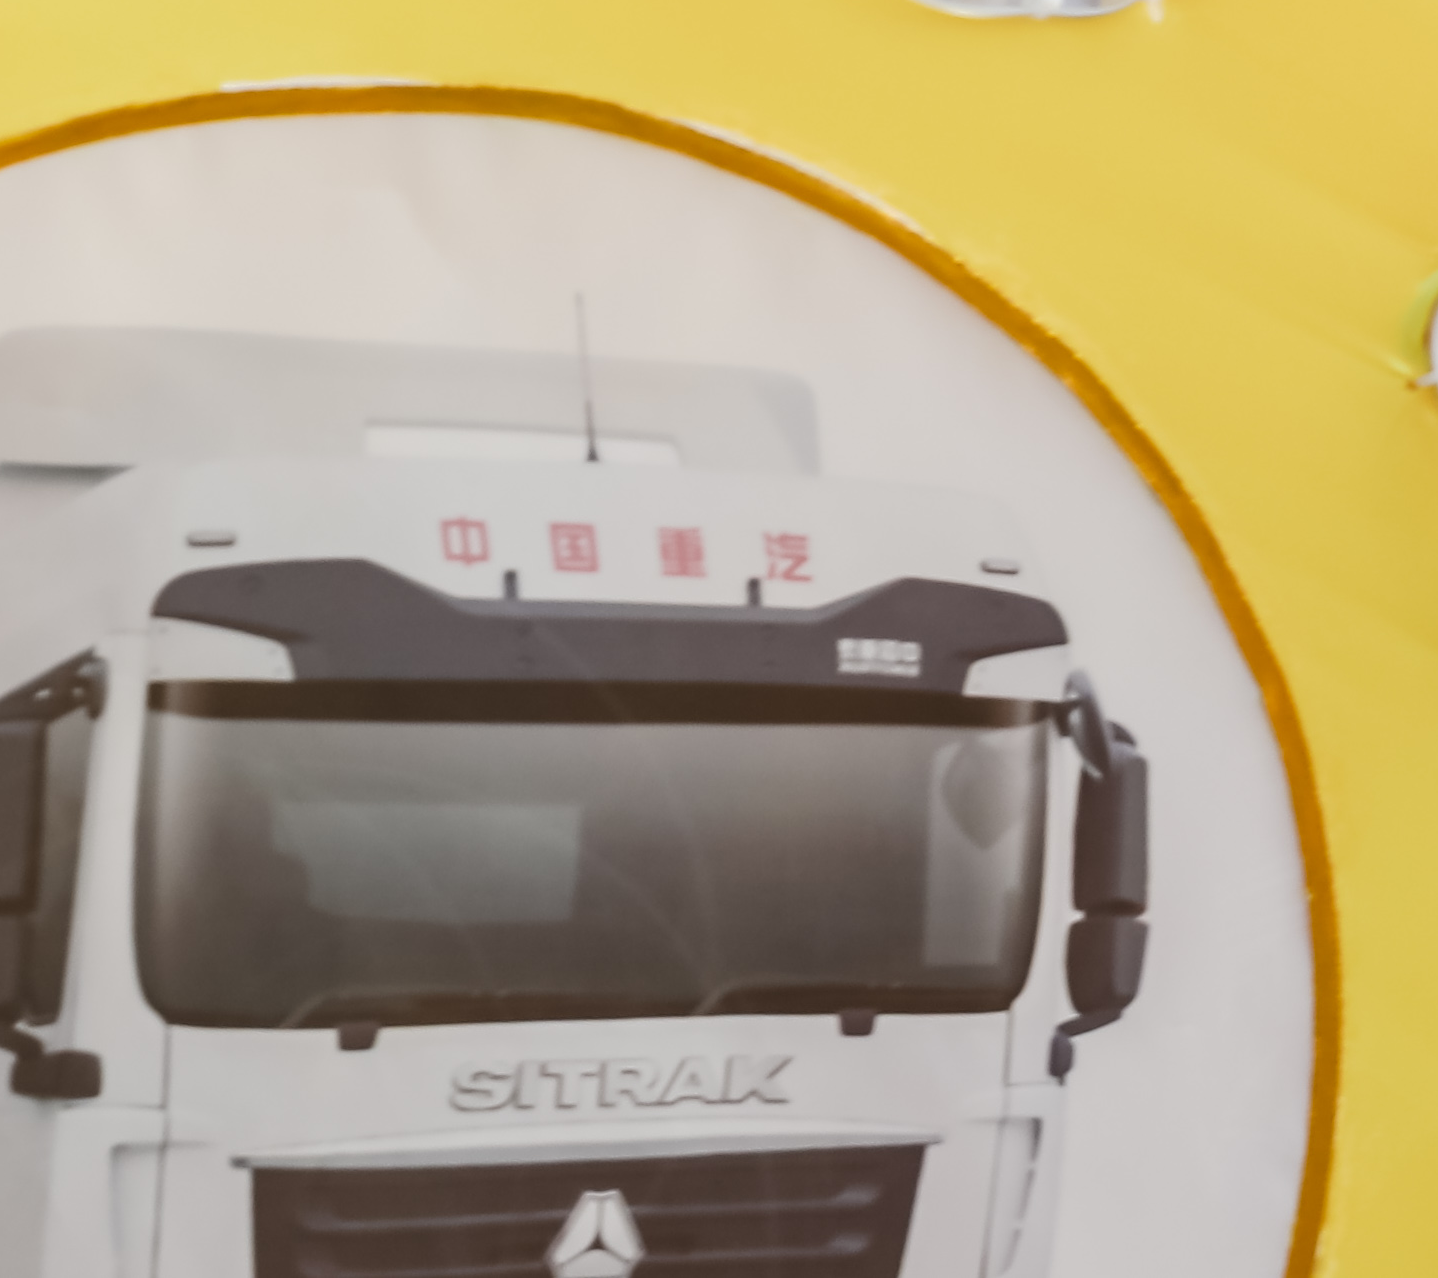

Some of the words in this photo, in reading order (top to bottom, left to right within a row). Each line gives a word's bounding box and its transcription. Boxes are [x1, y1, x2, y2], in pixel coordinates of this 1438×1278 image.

[439, 516, 814, 583] 中国重汽
[449, 1055, 794, 1113] SITRAK
